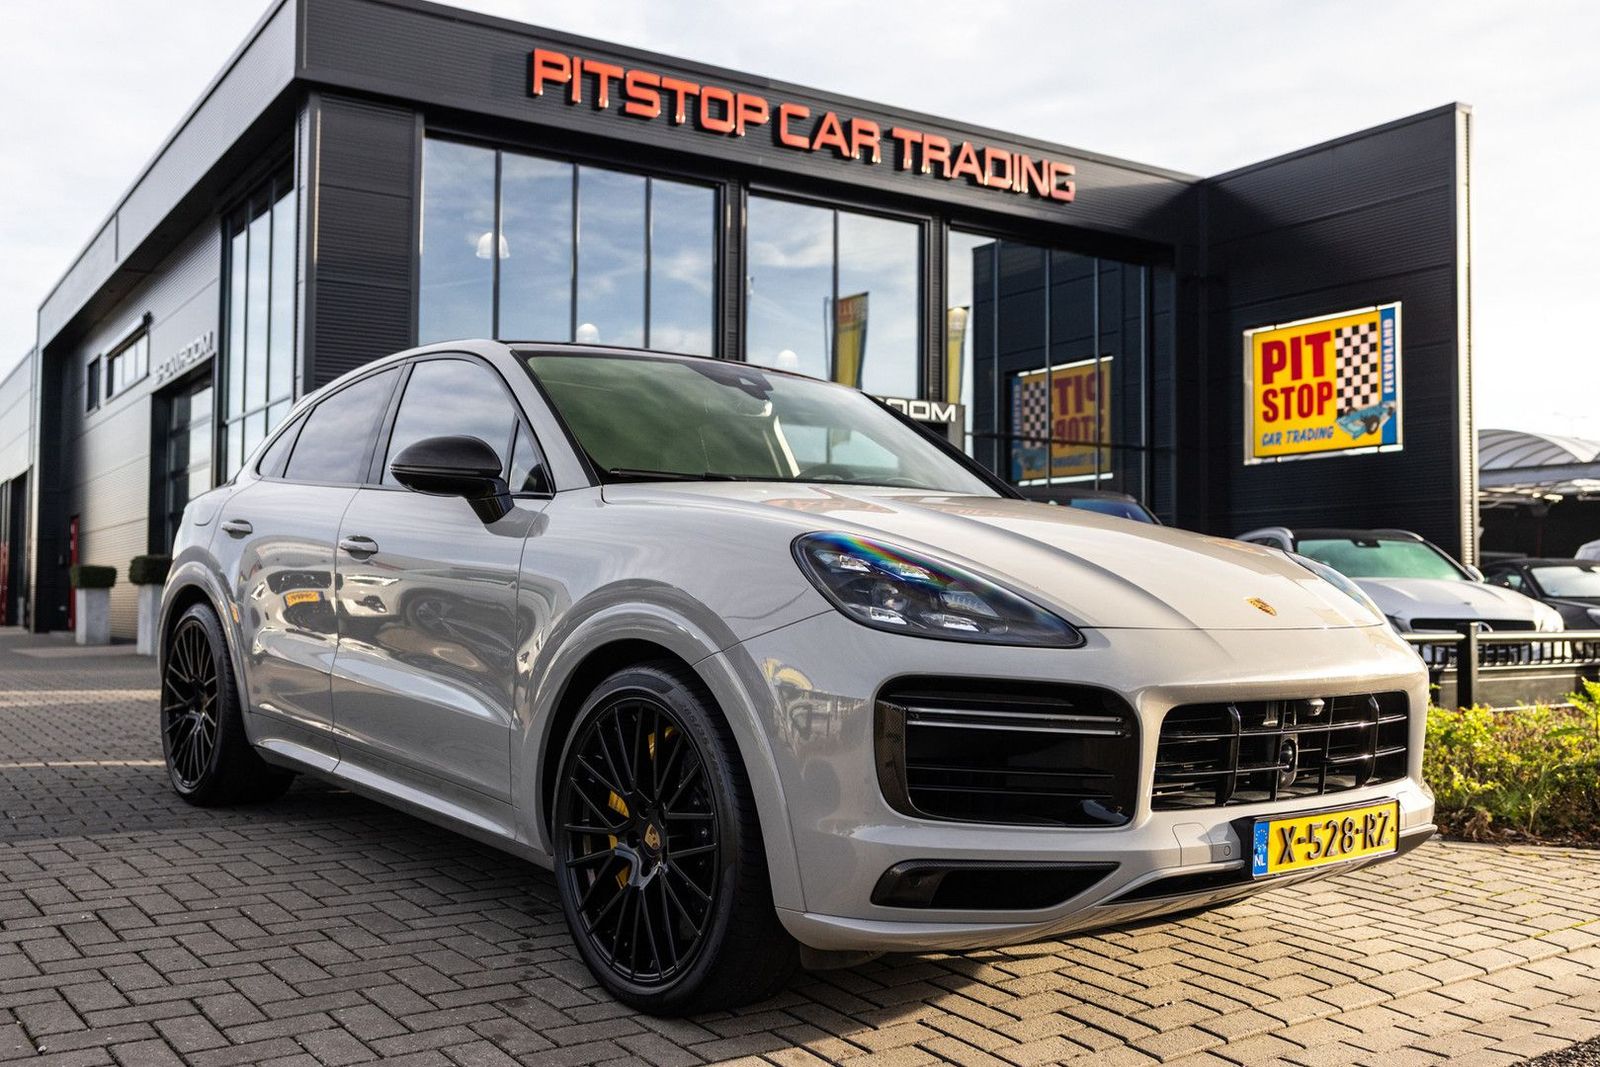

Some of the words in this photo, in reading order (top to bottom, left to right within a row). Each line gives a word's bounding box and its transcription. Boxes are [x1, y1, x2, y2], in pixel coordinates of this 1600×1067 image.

[532, 47, 769, 137] PITSTOP
[779, 103, 882, 164] CAR
[891, 126, 1076, 202] TRADING
[1261, 331, 1331, 385] PIT
[1382, 318, 1394, 394] FLEVOLAND
[876, 396, 956, 422] OOM
[1262, 381, 1333, 424] STOP
[1262, 431, 1283, 447] CAR
[1286, 426, 1334, 444] TRADING
[1254, 855, 1266, 866] NL
[1279, 811, 1390, 863] X-528-RZ
